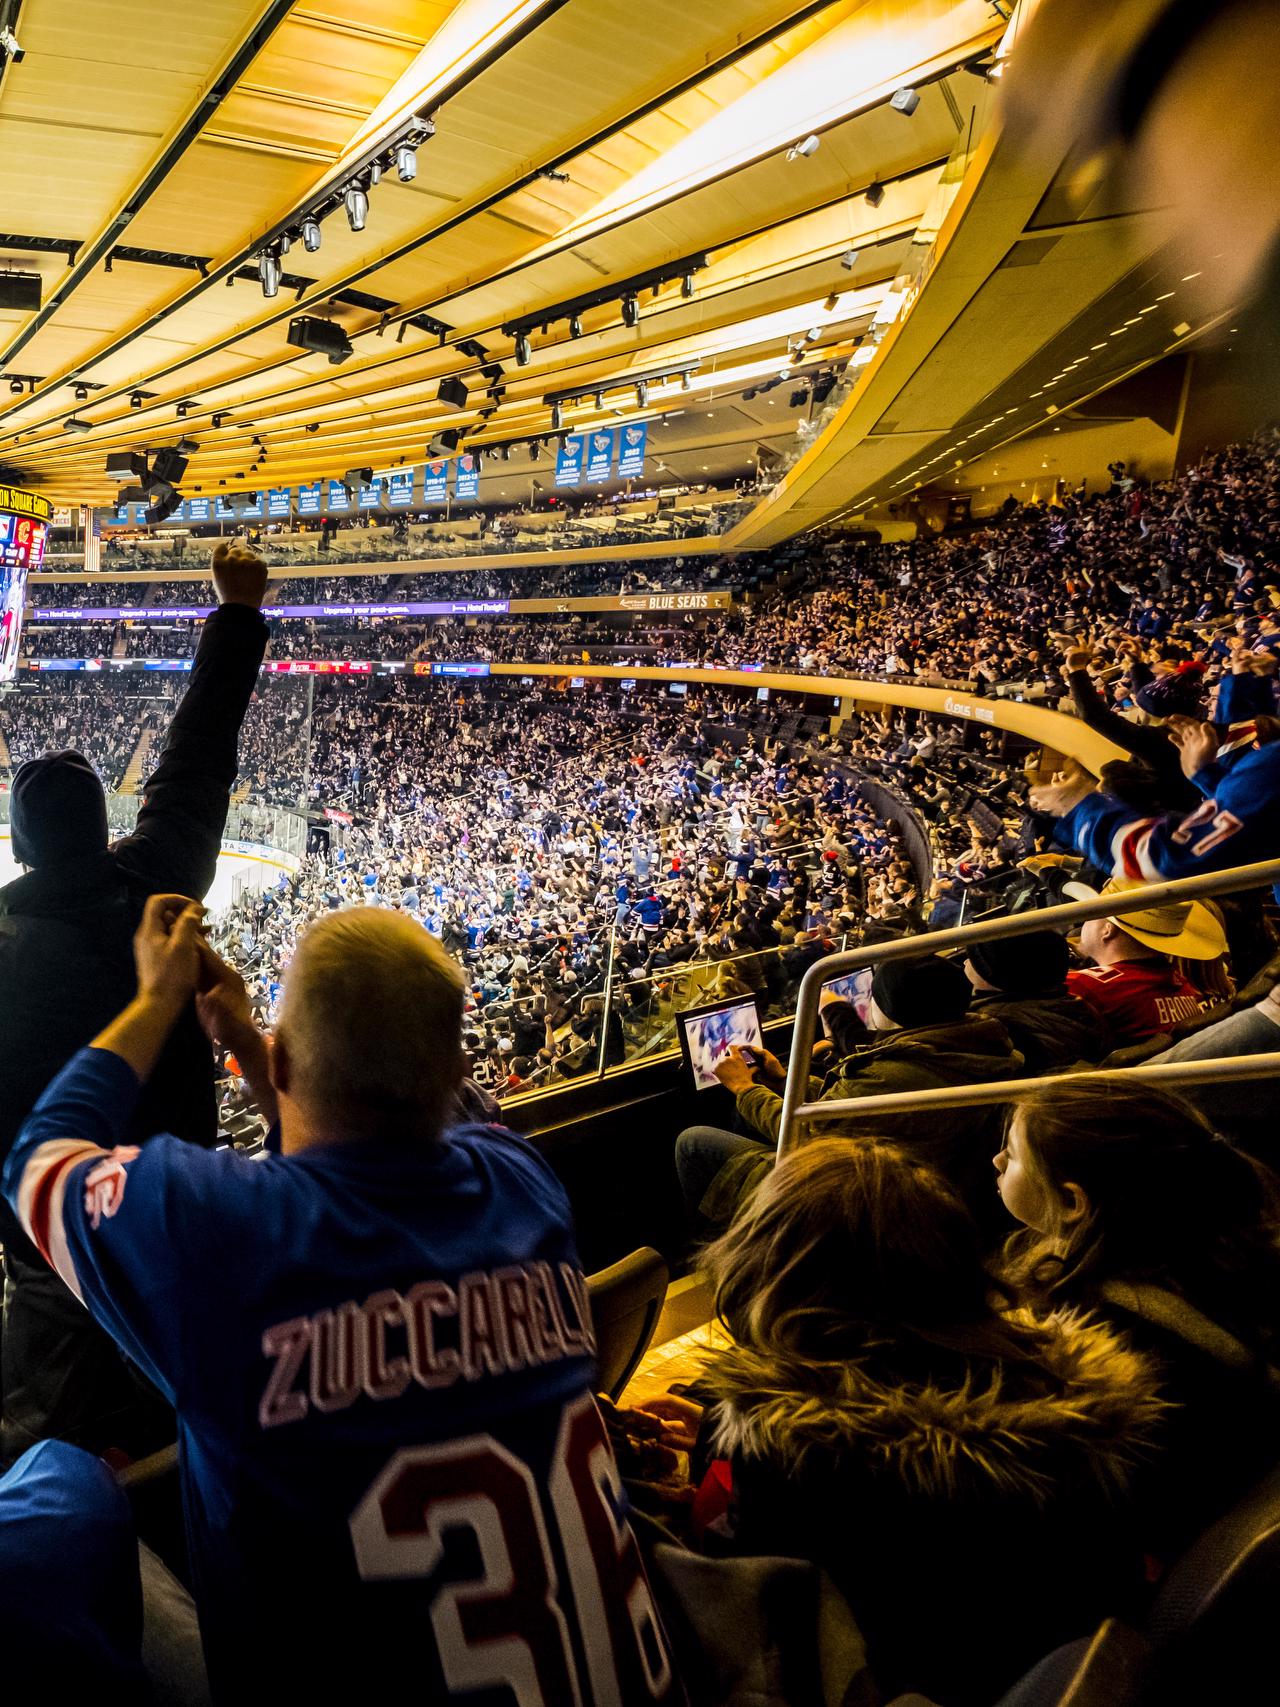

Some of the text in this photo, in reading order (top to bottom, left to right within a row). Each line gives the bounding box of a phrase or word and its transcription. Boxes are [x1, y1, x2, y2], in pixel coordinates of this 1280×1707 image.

[10, 489, 34, 511] SQUARE
[649, 597, 675, 609] BLUE
[677, 595, 708, 608] SEATS
[323, 607, 353, 616] Upgrade
[354, 607, 369, 615] your
[467, 603, 506, 613] HotelTonight
[119, 610, 146, 618] Upgrade
